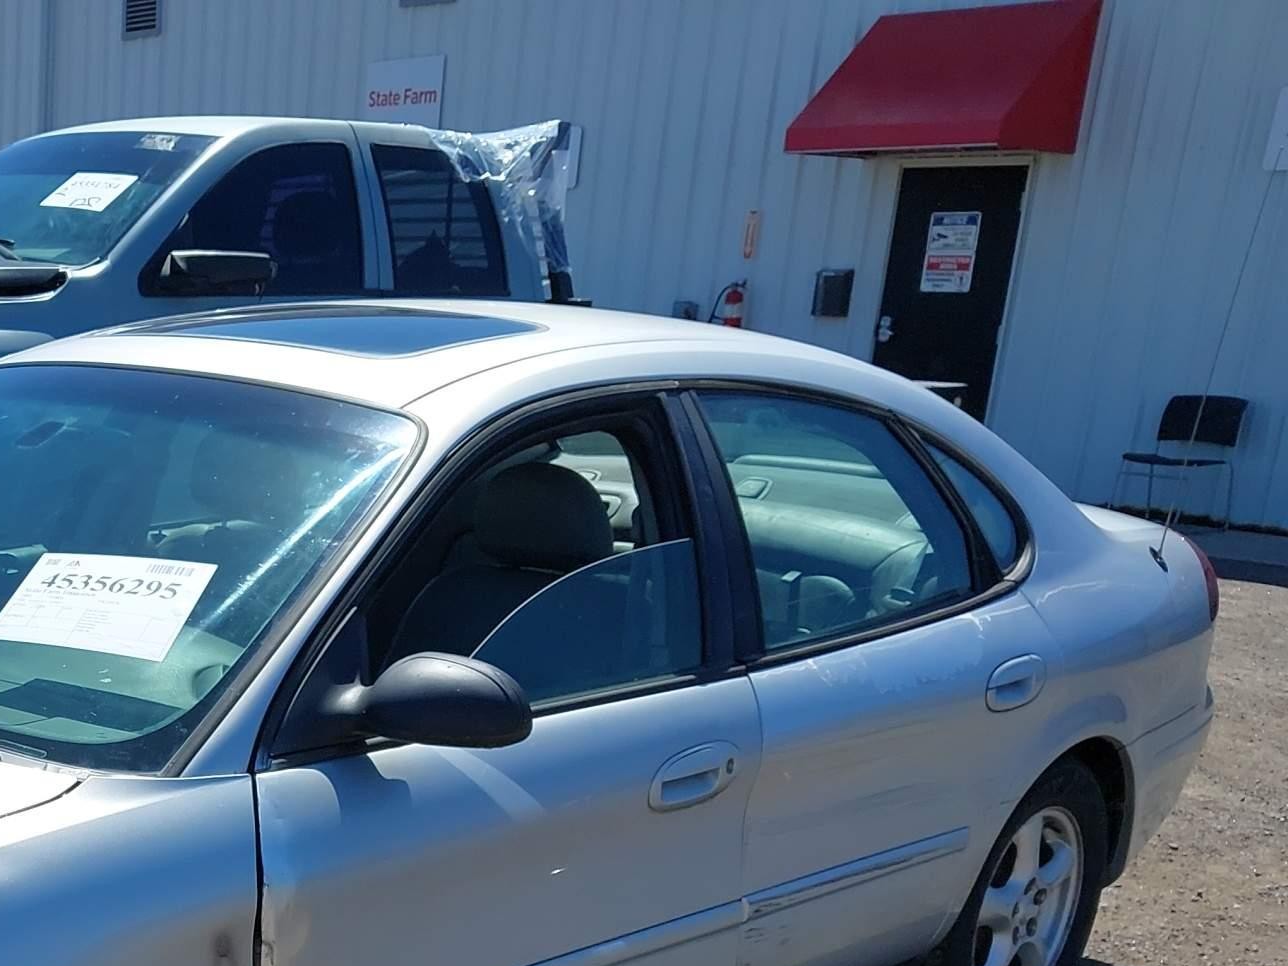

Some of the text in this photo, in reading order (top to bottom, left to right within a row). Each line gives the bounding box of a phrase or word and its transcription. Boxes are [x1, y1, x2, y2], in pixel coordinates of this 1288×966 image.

[368, 88, 437, 108] State Farm
[40, 572, 183, 600] 45356295
